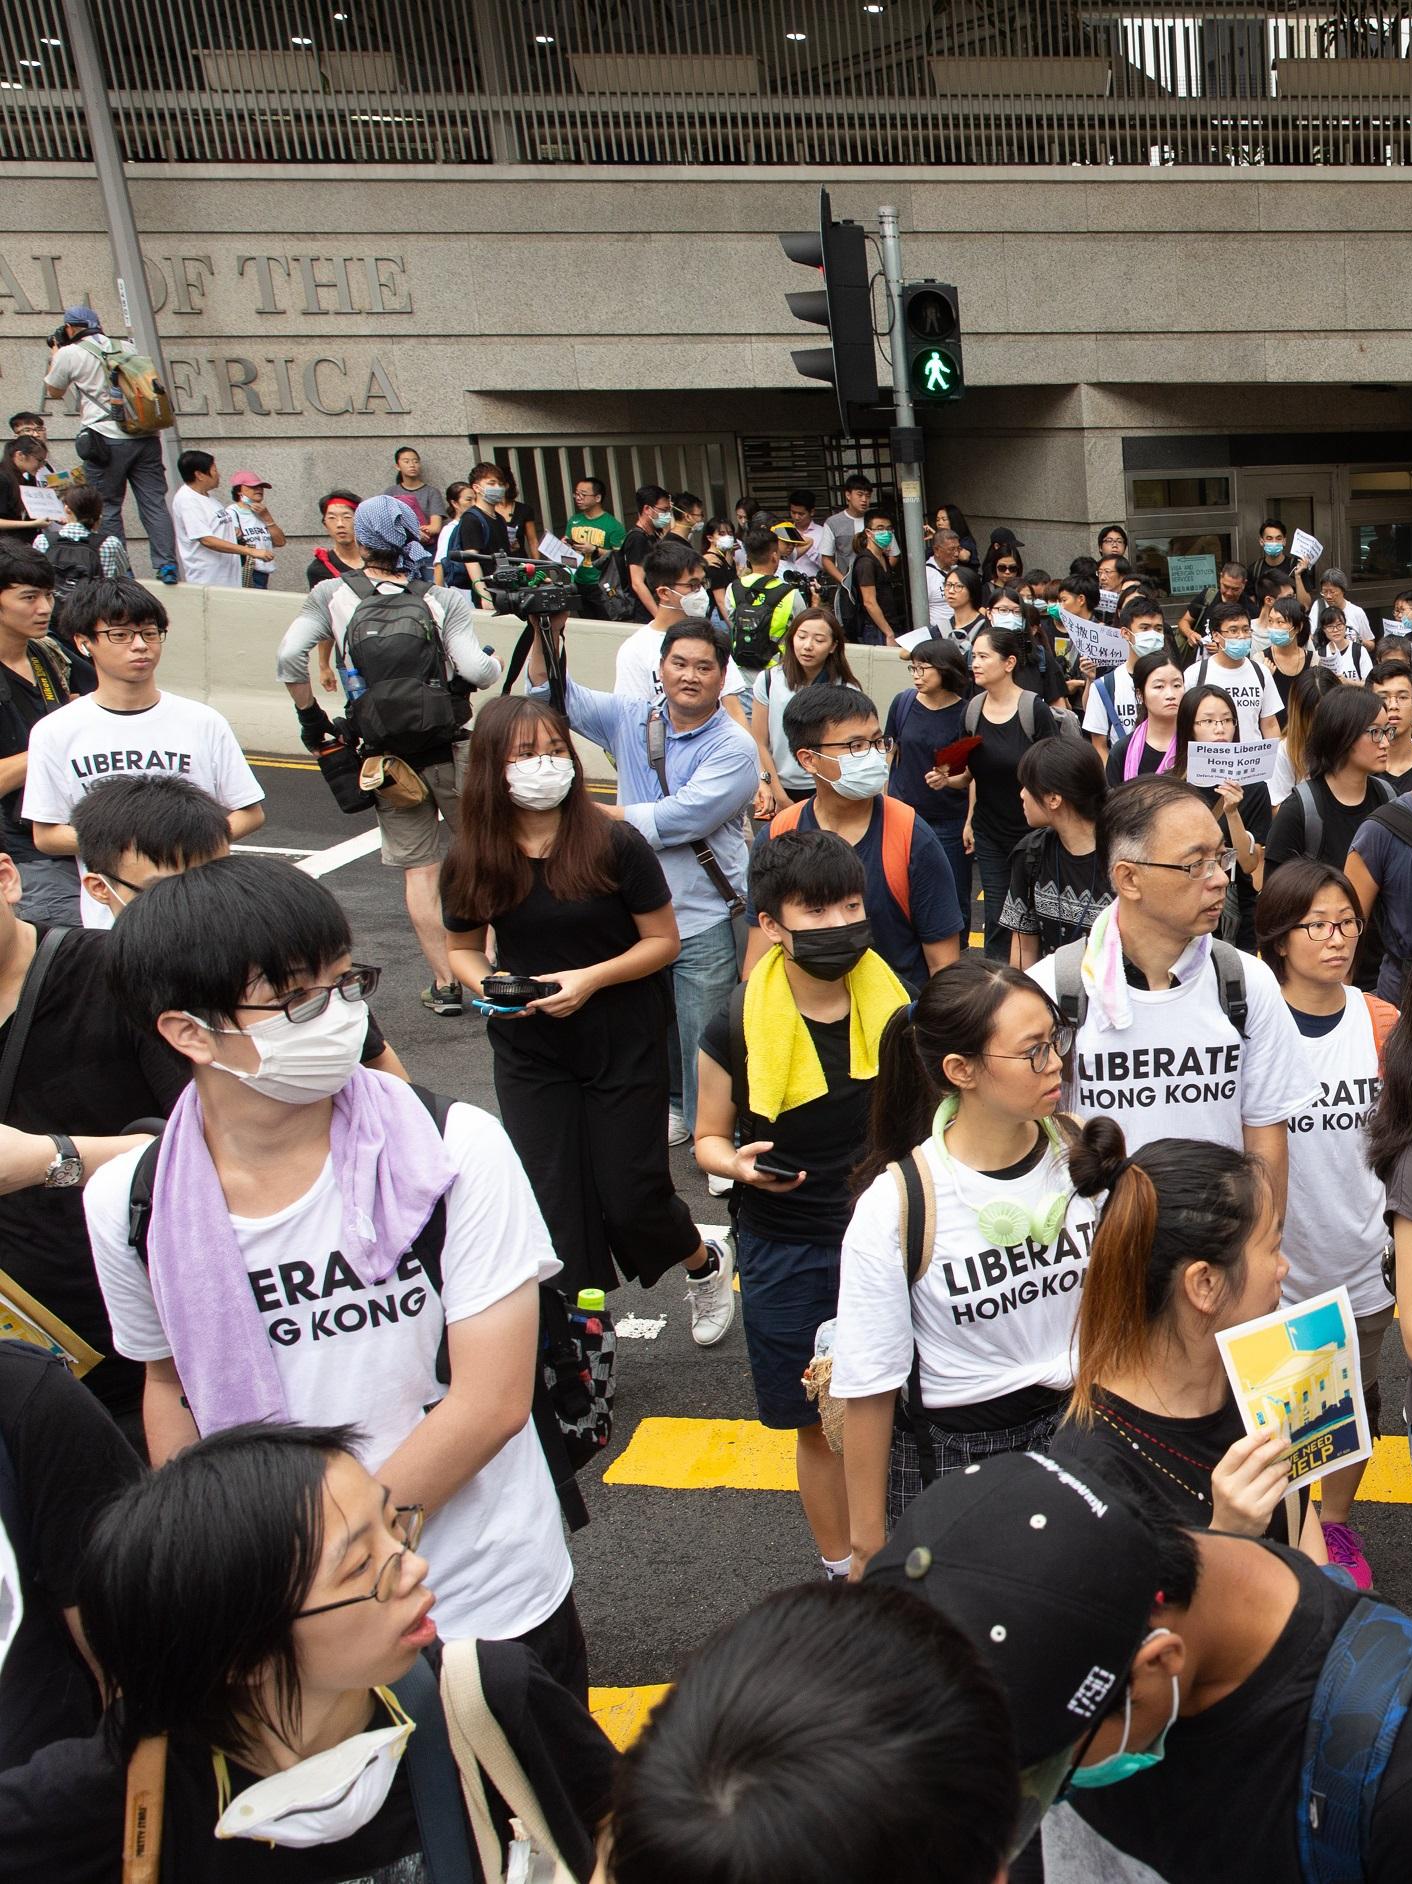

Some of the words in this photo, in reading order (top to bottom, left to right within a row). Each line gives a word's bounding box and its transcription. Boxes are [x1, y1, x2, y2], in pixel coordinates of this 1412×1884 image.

[236, 255, 413, 315] THE
[38, 357, 411, 416] ERICA
[40, 677, 56, 701] Nikon
[1237, 699, 1260, 707] KONG
[1196, 745, 1231, 754] Please
[1234, 743, 1272, 754] Liberate
[1207, 758, 1234, 767] Hong
[1237, 757, 1261, 767] Kong
[71, 750, 191, 778] LIBERATE
[1078, 1043, 1241, 1082] LIBERATE
[1080, 1086, 1156, 1109] HONG
[1165, 1079, 1237, 1104] KONG
[943, 1221, 1096, 1297] LIBERAT
[248, 1250, 422, 1313] ERAE
[1042, 1268, 1088, 1298] KO
[269, 1317, 301, 1348] G
[311, 1286, 427, 1341] KONG
[1303, 1434, 1333, 1456] NEED
